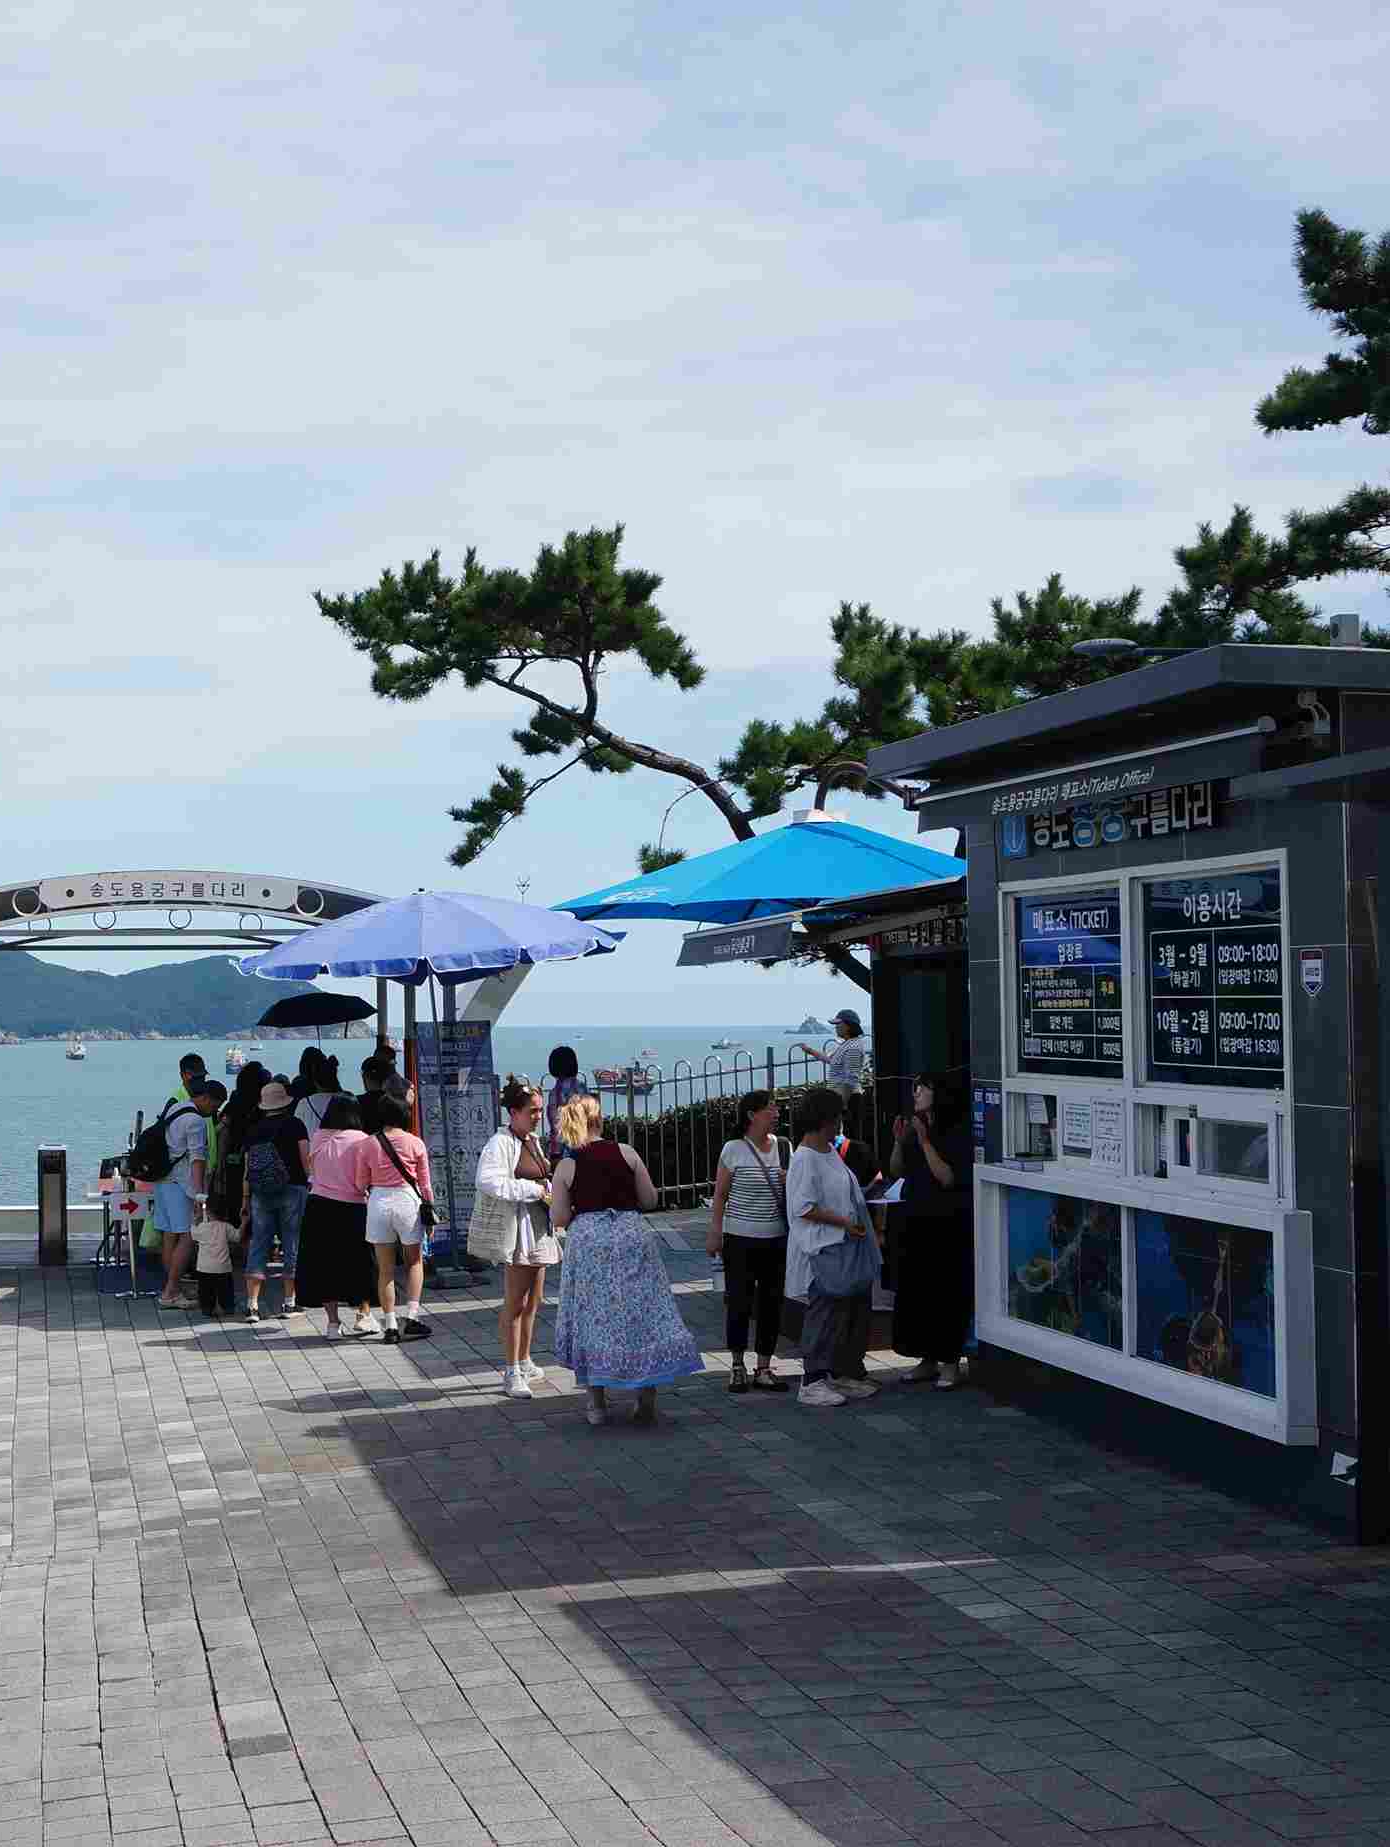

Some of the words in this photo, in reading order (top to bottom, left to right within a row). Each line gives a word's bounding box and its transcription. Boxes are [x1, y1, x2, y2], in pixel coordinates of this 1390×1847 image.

[90, 882, 246, 898] 송도용궁구름다리
[1183, 888, 1243, 923] 이용시간
[1033, 908, 1067, 931] 매표소
[1070, 907, 1110, 929] (TICKET)
[1158, 943, 1176, 968] 3월
[1189, 943, 1208, 967] 9월
[1156, 1009, 1178, 1033] 10월
[1191, 1009, 1209, 1034] 2월
